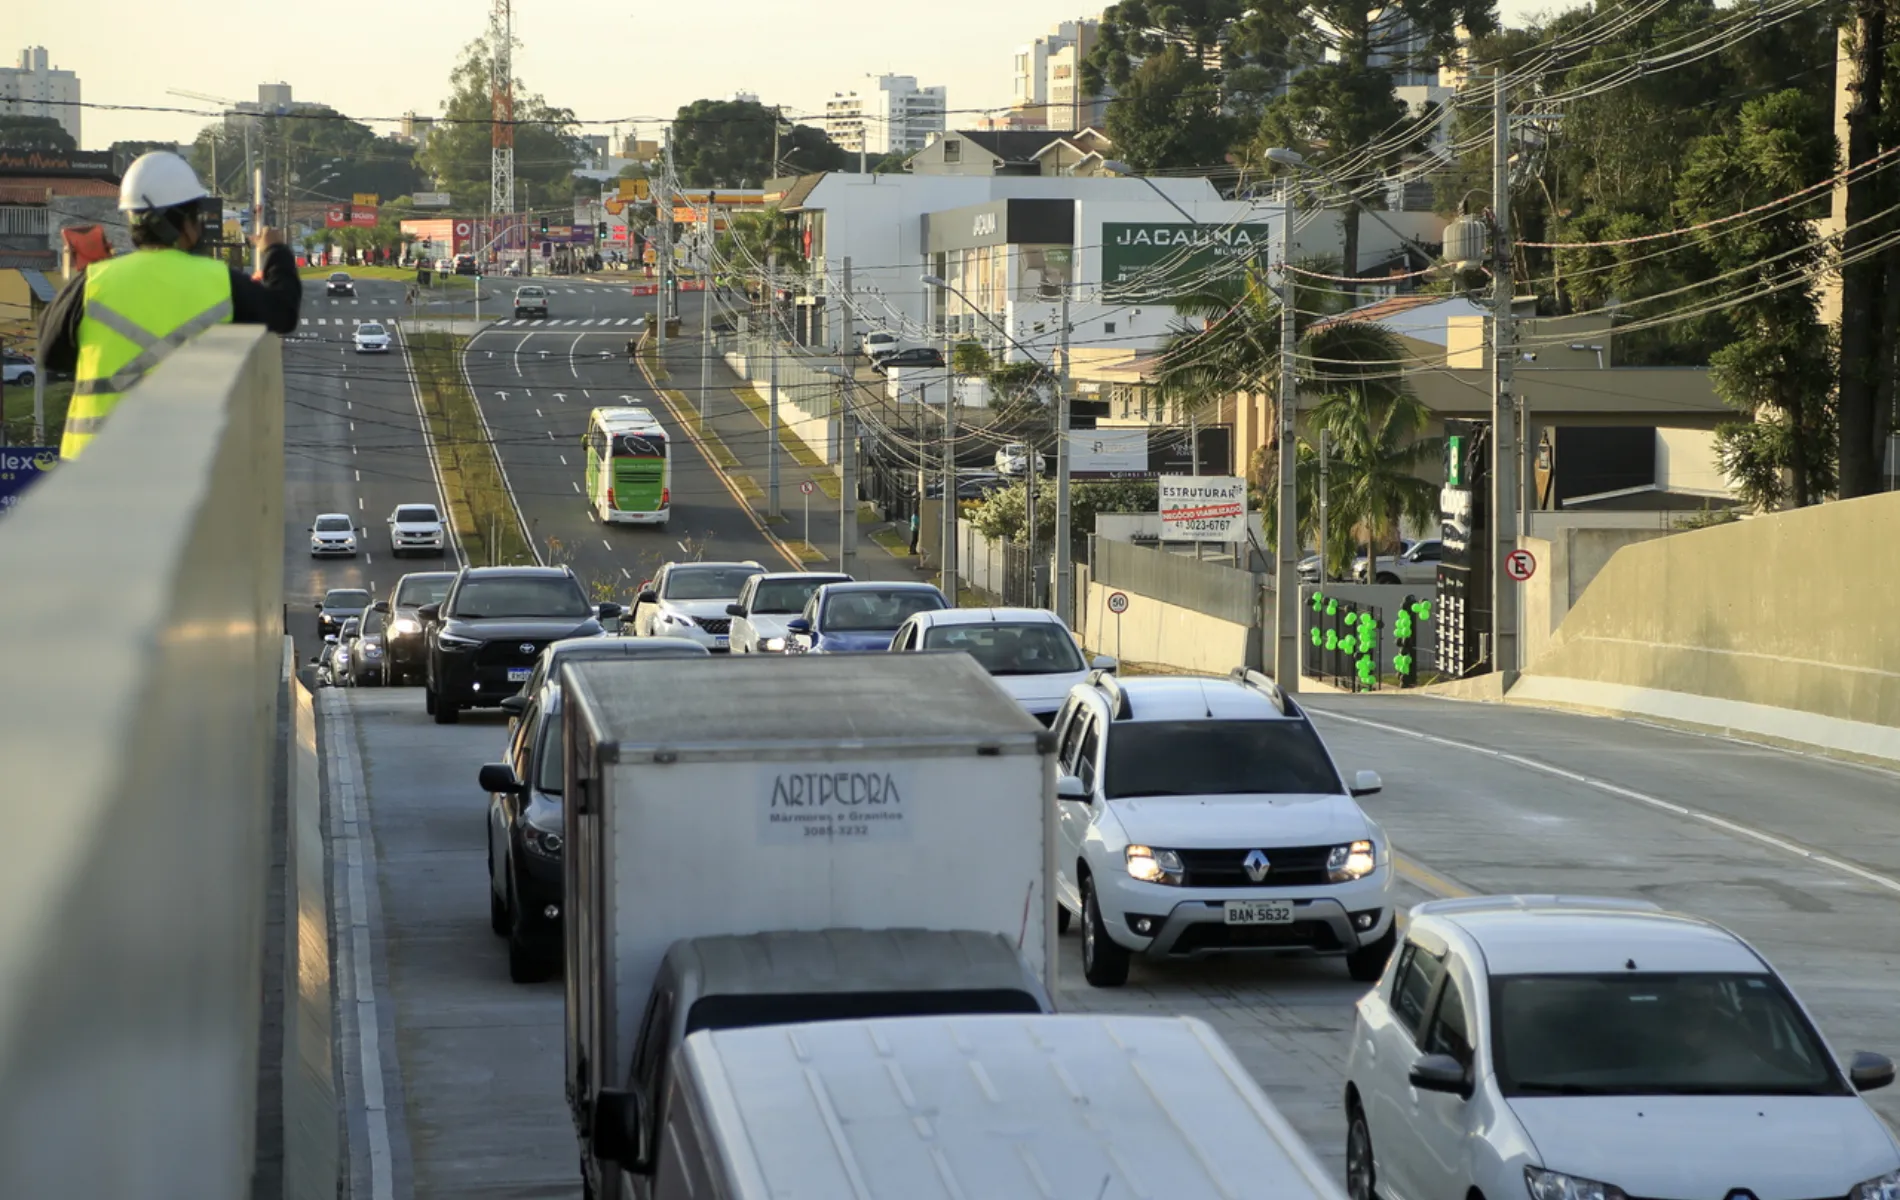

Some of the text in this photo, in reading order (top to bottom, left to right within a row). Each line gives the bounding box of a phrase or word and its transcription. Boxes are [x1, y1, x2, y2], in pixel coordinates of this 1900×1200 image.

[1163, 487, 1236, 498] ESTRUTURAR
[1185, 520, 1231, 530] 3023-6767
[1112, 597, 1125, 607] 50
[771, 771, 902, 808] ARTPEDRA
[837, 813, 846, 822] e
[849, 811, 904, 822] Granitos
[1229, 907, 1290, 921] BAN-5632
